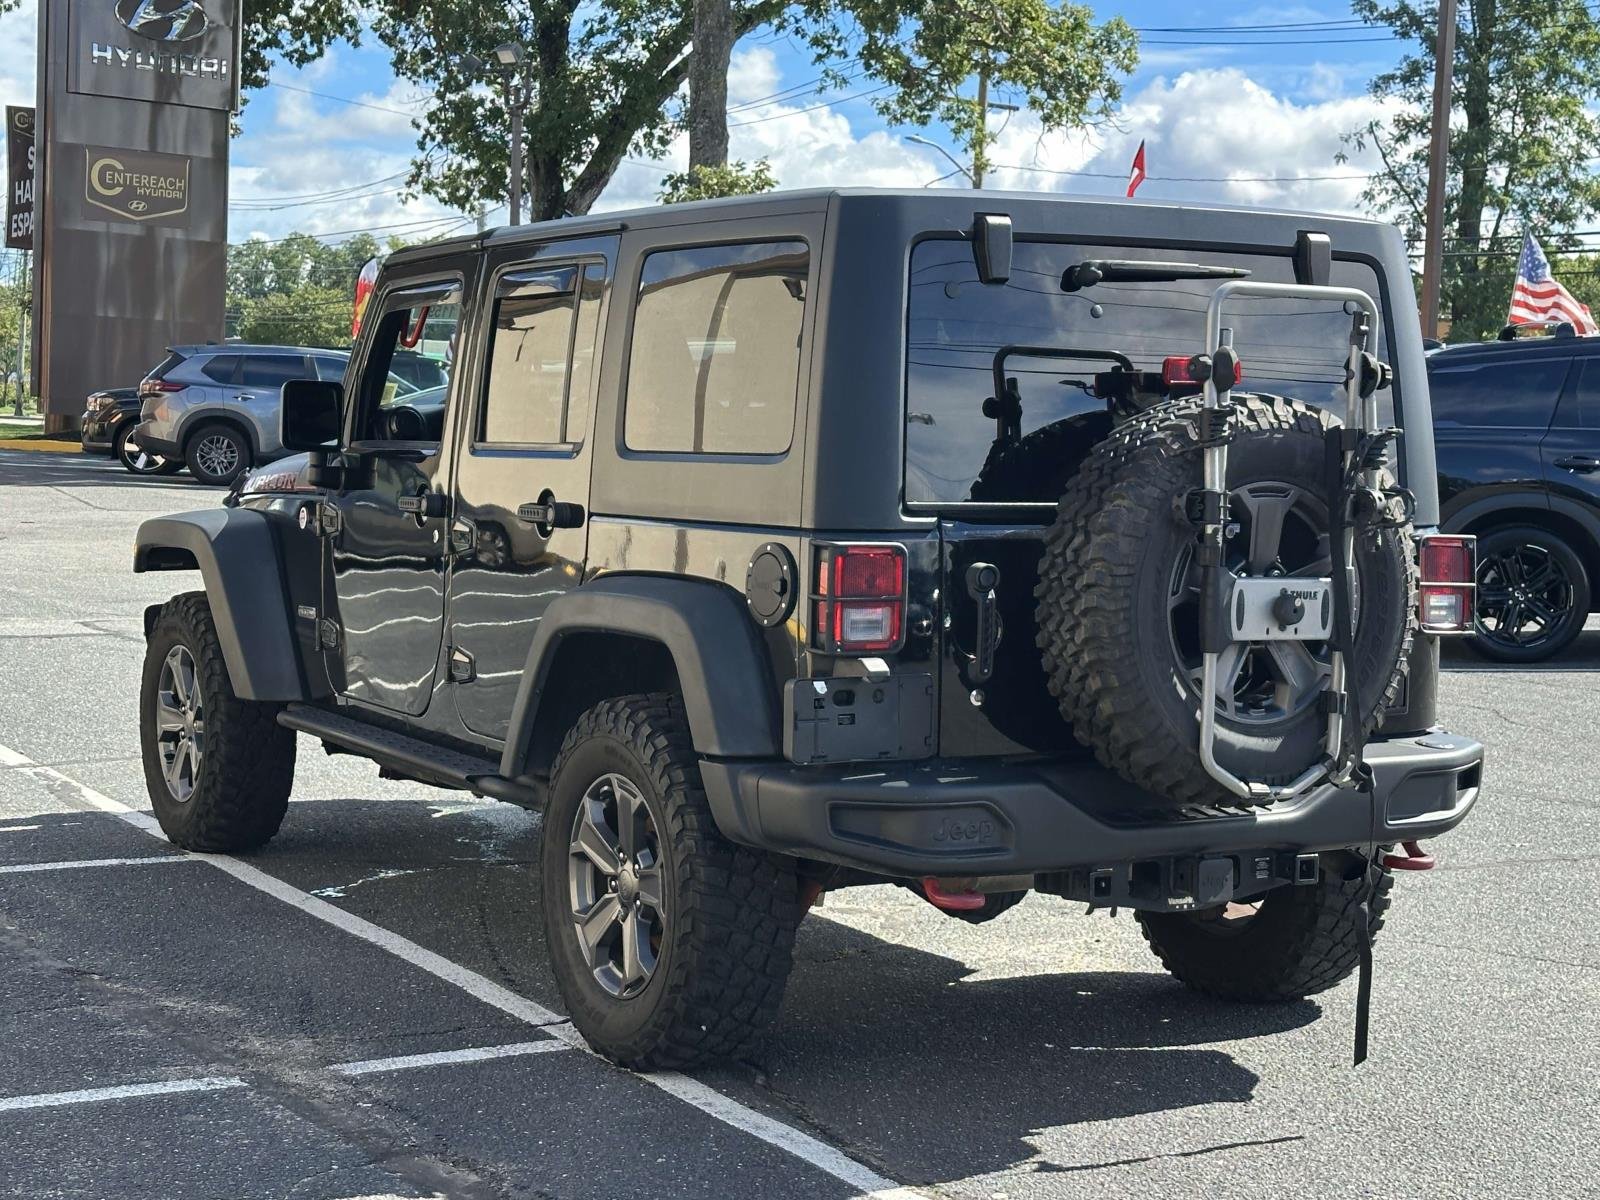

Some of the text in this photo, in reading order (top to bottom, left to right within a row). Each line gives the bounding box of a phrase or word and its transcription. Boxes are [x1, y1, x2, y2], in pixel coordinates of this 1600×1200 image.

[92, 42, 228, 80] HYUNDAI
[91, 158, 184, 196] CENTEREACH
[15, 178, 35, 205] HA
[137, 187, 183, 199] HYUNDAI
[1289, 590, 1319, 601] THULE
[931, 816, 994, 845] Jeep
